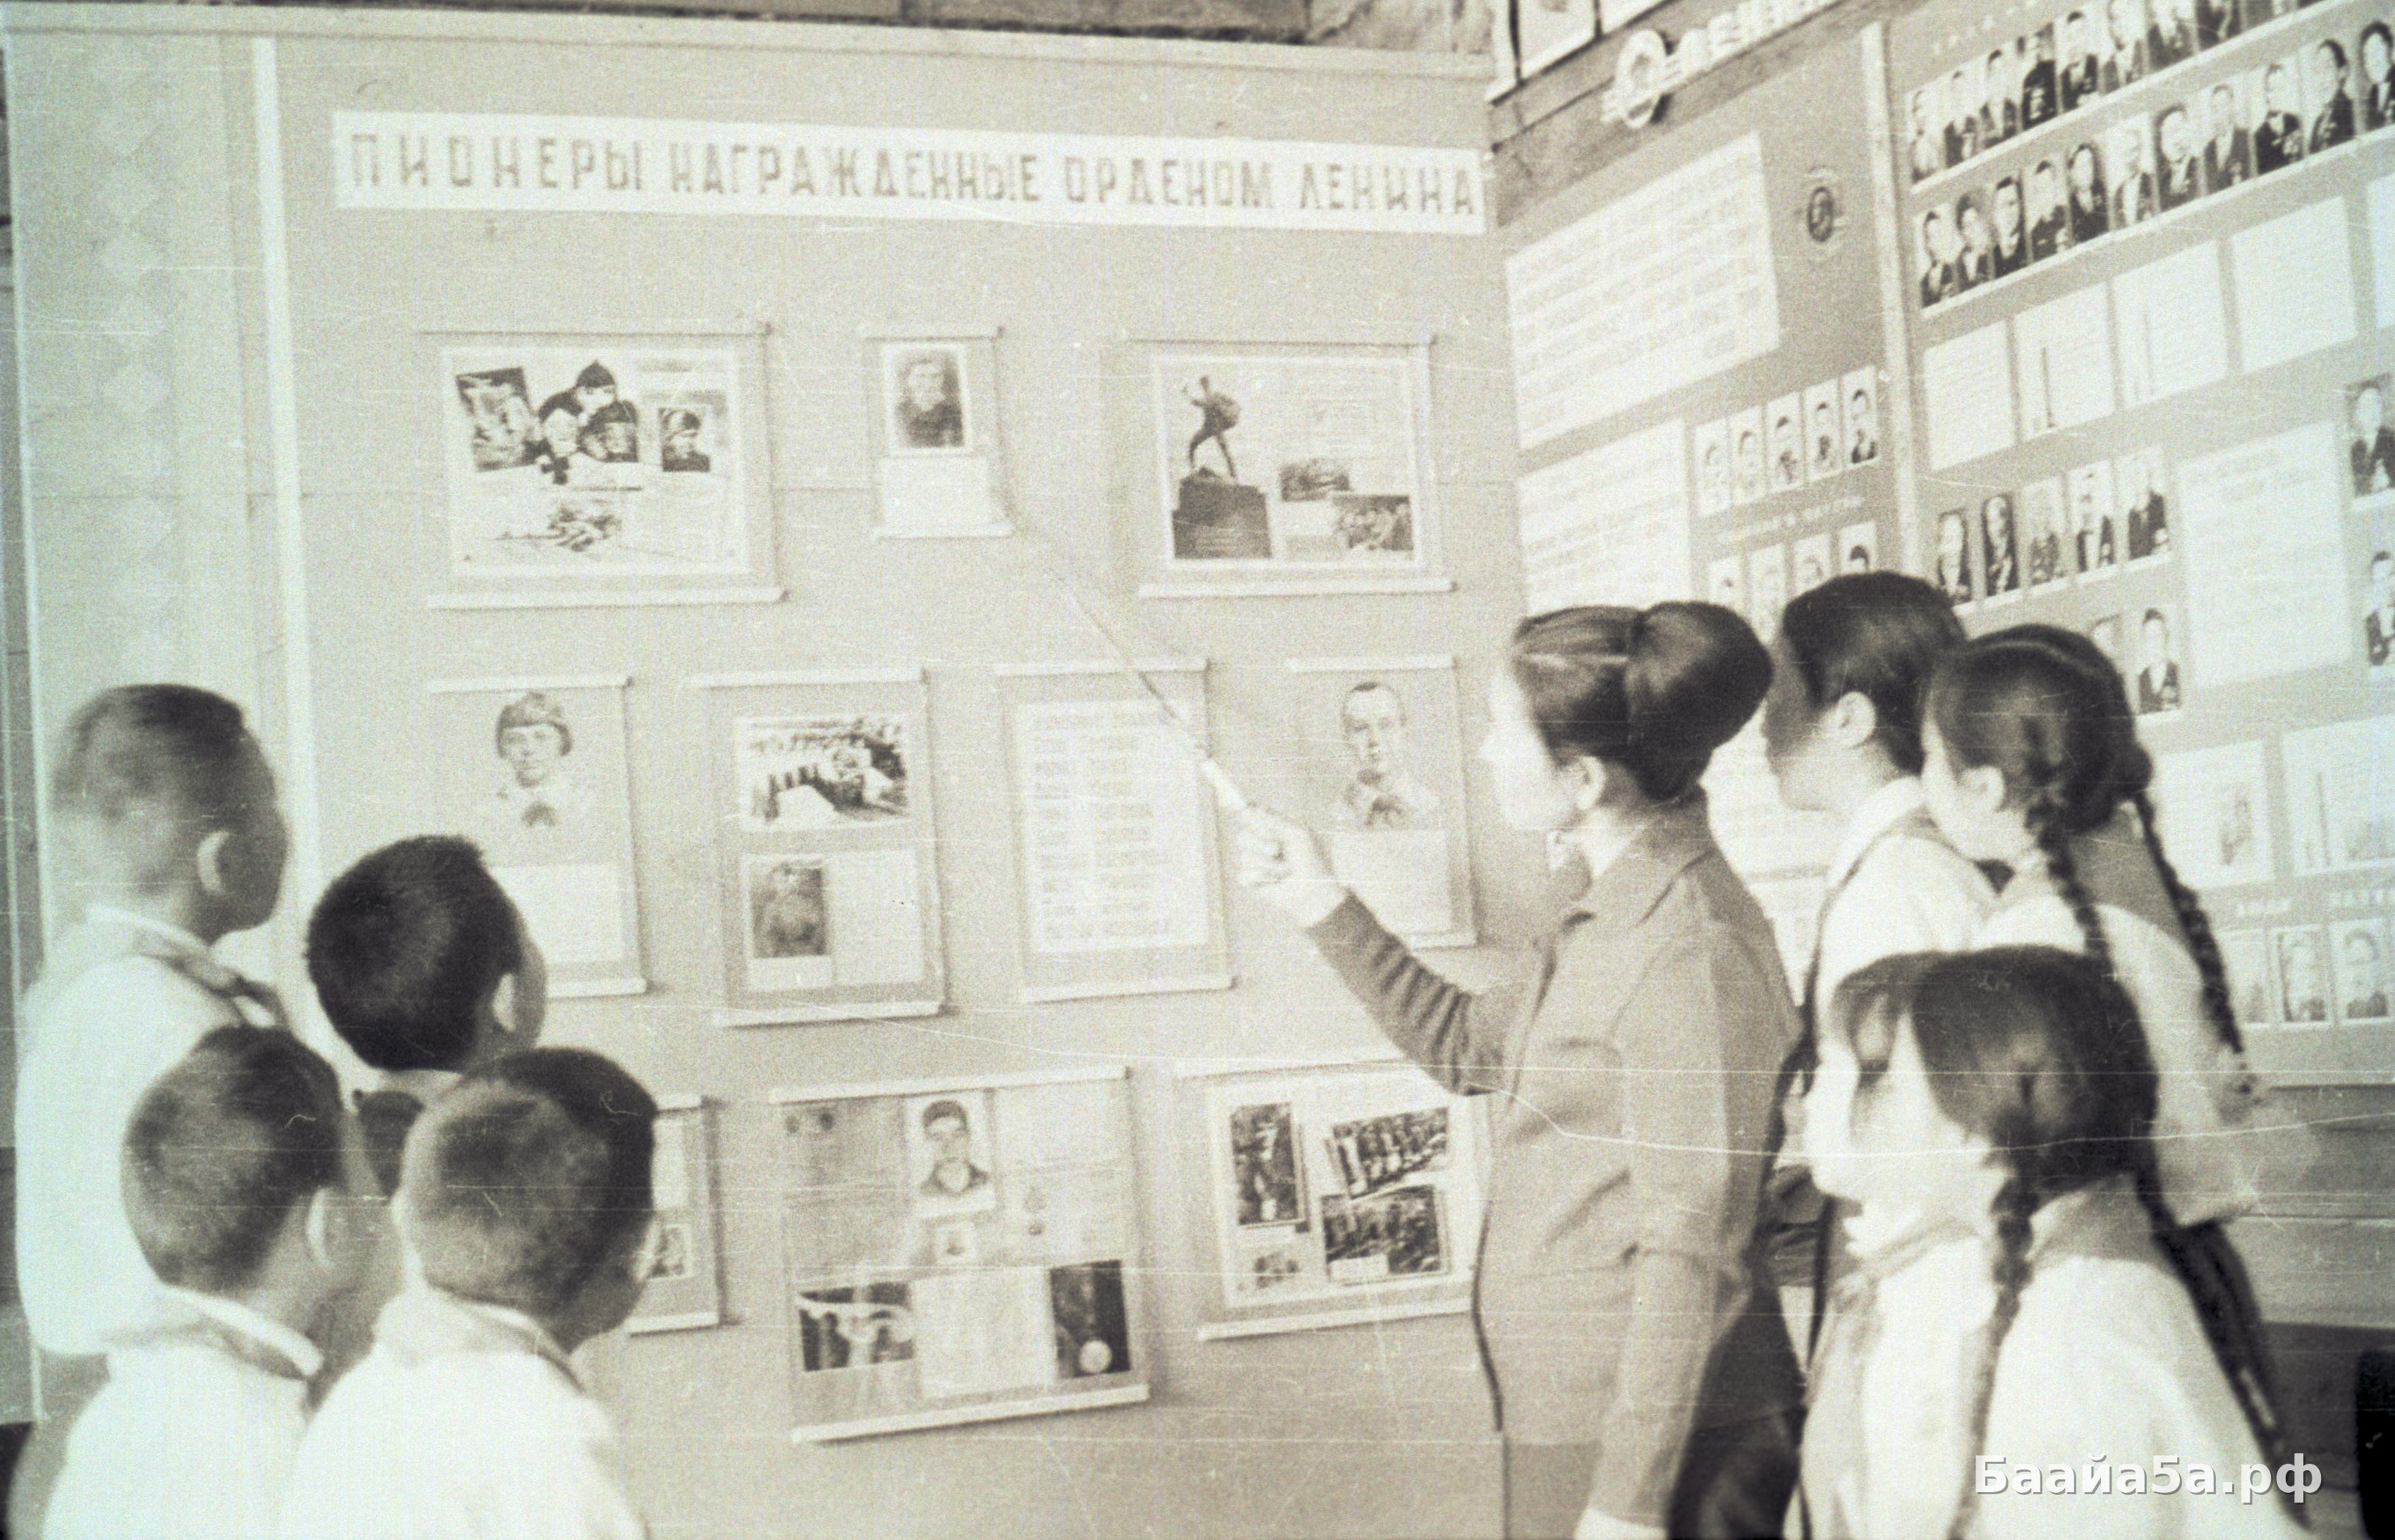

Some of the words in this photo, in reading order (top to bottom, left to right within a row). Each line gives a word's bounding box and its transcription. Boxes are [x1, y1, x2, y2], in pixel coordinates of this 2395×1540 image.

[352, 133, 644, 191] ПИОНЕРЫ
[669, 142, 1040, 202] НАГРАЖДЕННЫЕ
[1064, 155, 1274, 209] ОРДЕНОМ
[1299, 162, 1475, 215] ЛЕНИНА
